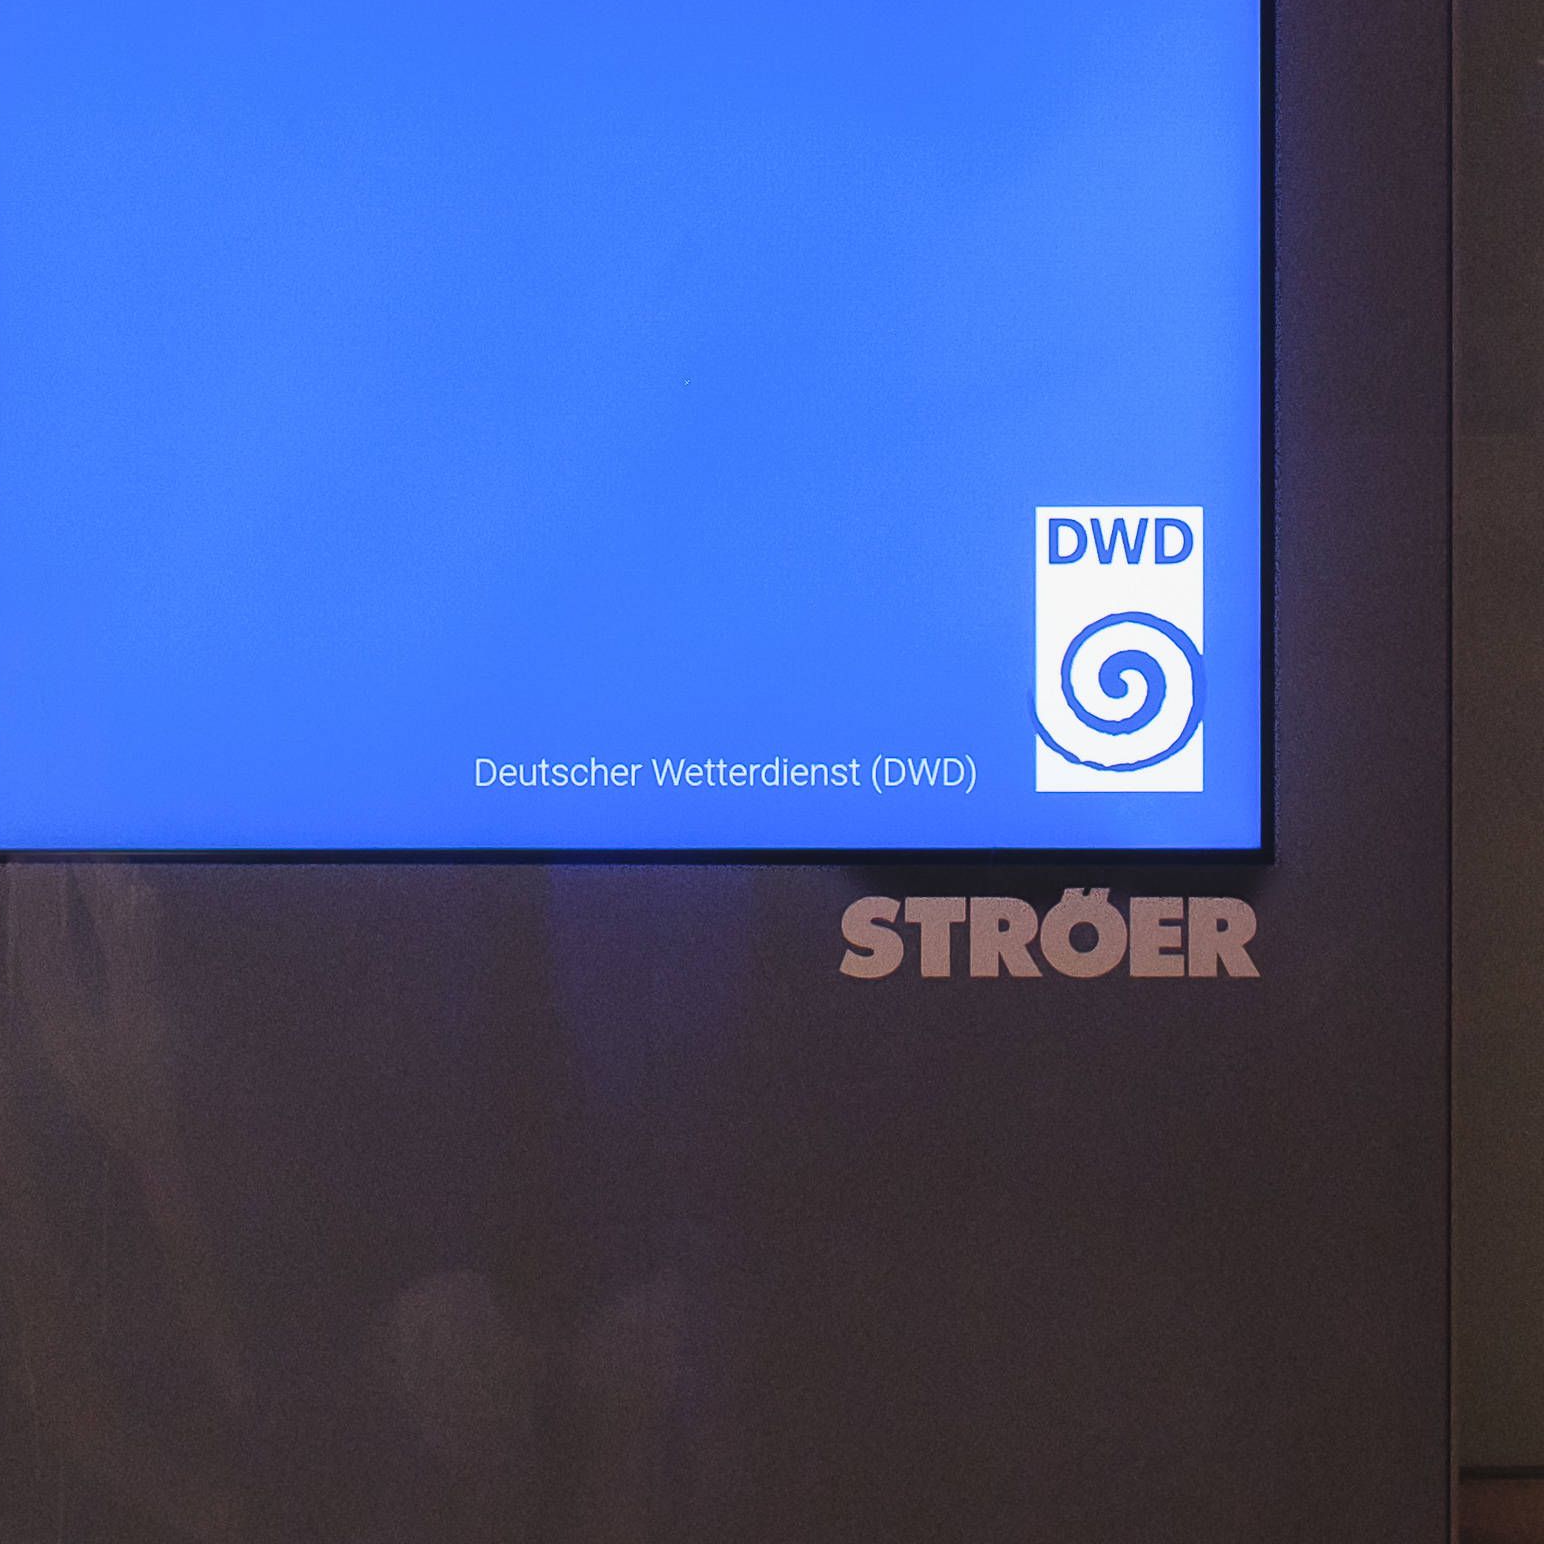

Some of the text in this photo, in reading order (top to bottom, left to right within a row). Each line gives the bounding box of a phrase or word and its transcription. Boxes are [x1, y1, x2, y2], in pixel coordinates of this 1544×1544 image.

[1048, 517, 1194, 565] DWD
[475, 754, 976, 794] Deutscher Wetterdienst (DWD)
[840, 888, 1260, 978] STRÖER
